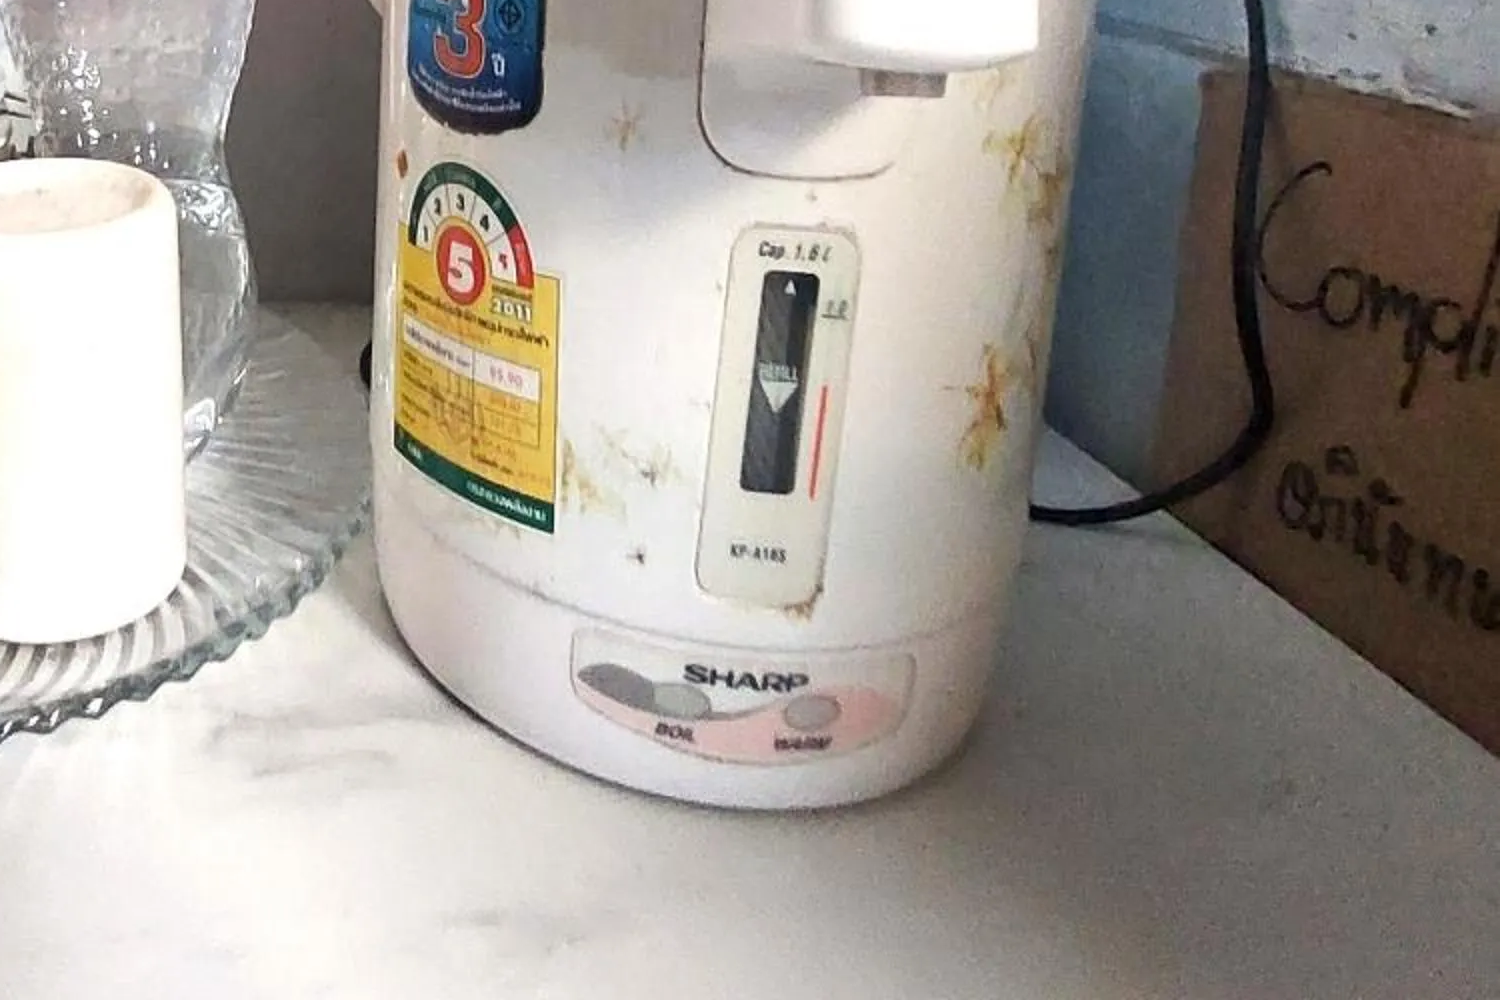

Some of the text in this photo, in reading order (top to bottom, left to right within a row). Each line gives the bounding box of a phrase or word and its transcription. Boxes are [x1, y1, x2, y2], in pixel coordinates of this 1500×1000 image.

[455, 192, 466, 212] 3
[479, 214, 490, 232] 4
[446, 240, 476, 295] 5
[490, 296, 533, 324] 2011
[682, 662, 810, 693] SHARP
